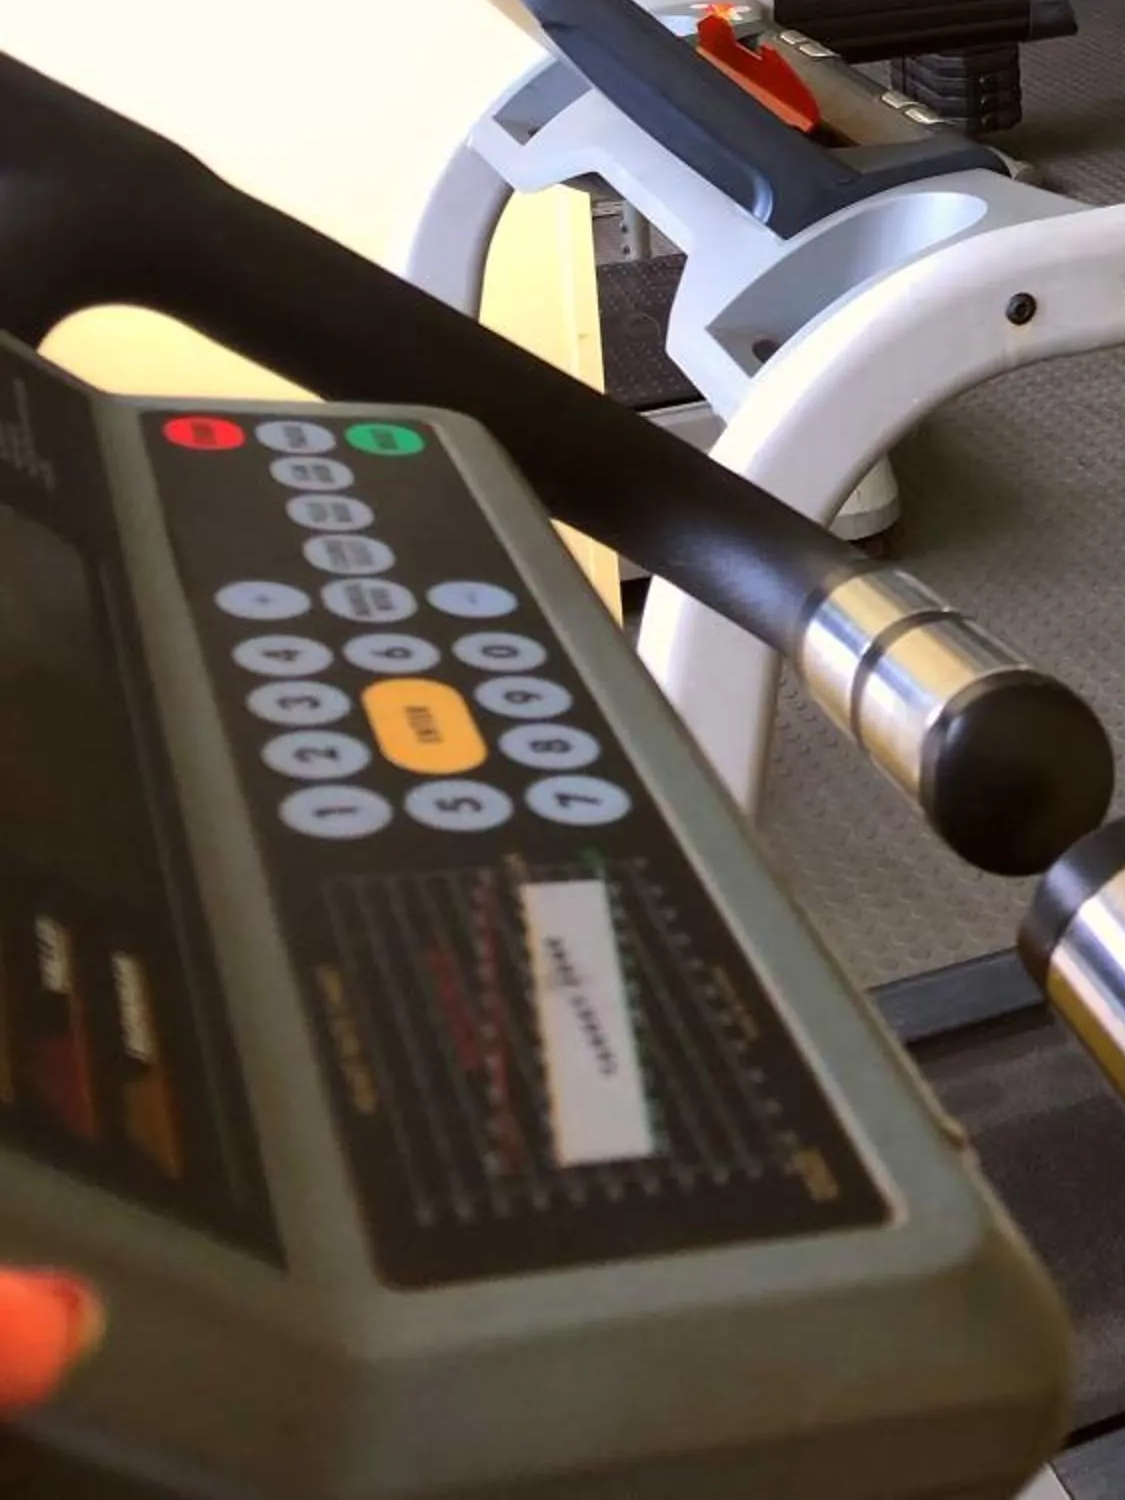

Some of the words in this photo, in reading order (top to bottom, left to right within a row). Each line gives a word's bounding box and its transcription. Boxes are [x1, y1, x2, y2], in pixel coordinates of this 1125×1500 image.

[262, 647, 300, 663] 4
[277, 694, 321, 711] 3
[293, 744, 339, 764] 2
[529, 737, 572, 755] 8
[435, 796, 484, 815] 5
